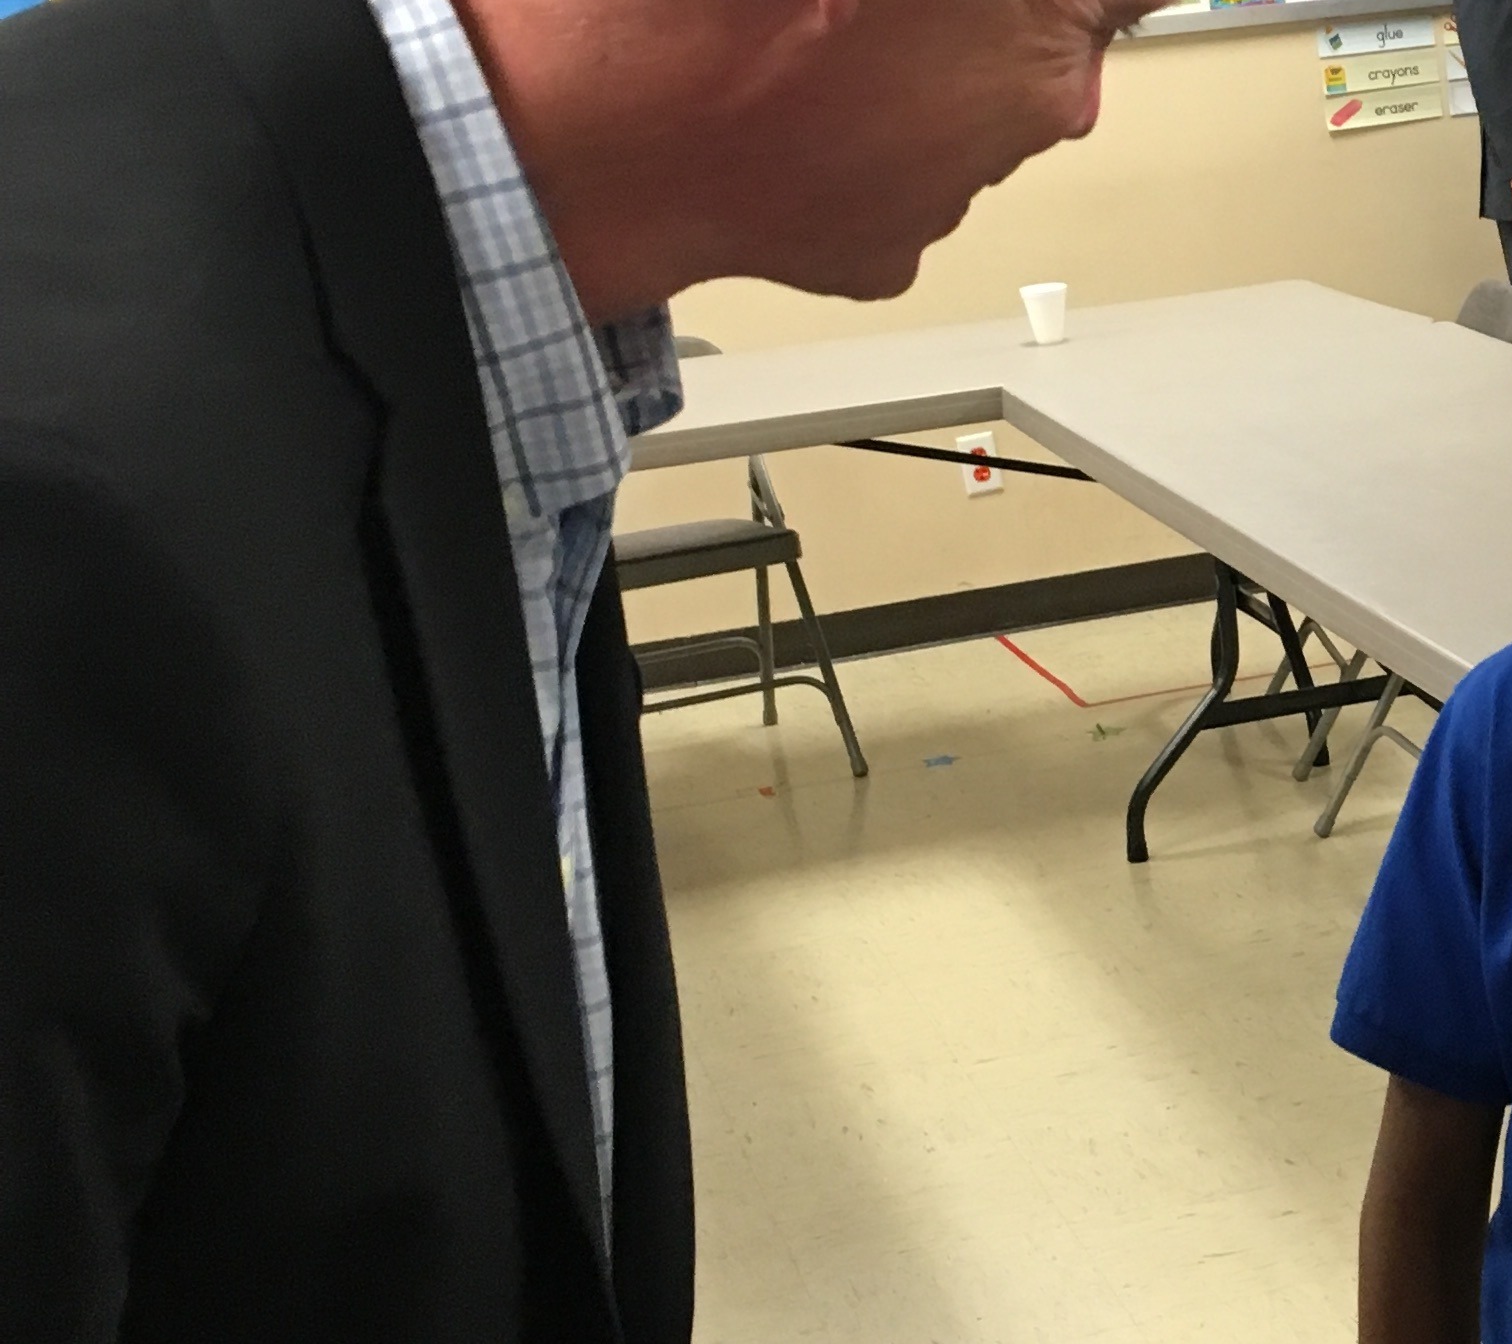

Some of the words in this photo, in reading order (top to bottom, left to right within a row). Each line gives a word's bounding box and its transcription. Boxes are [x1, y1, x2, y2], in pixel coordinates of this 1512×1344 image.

[1376, 23, 1404, 48] glue
[1368, 65, 1420, 86] crayons
[1374, 101, 1419, 116] eraser
